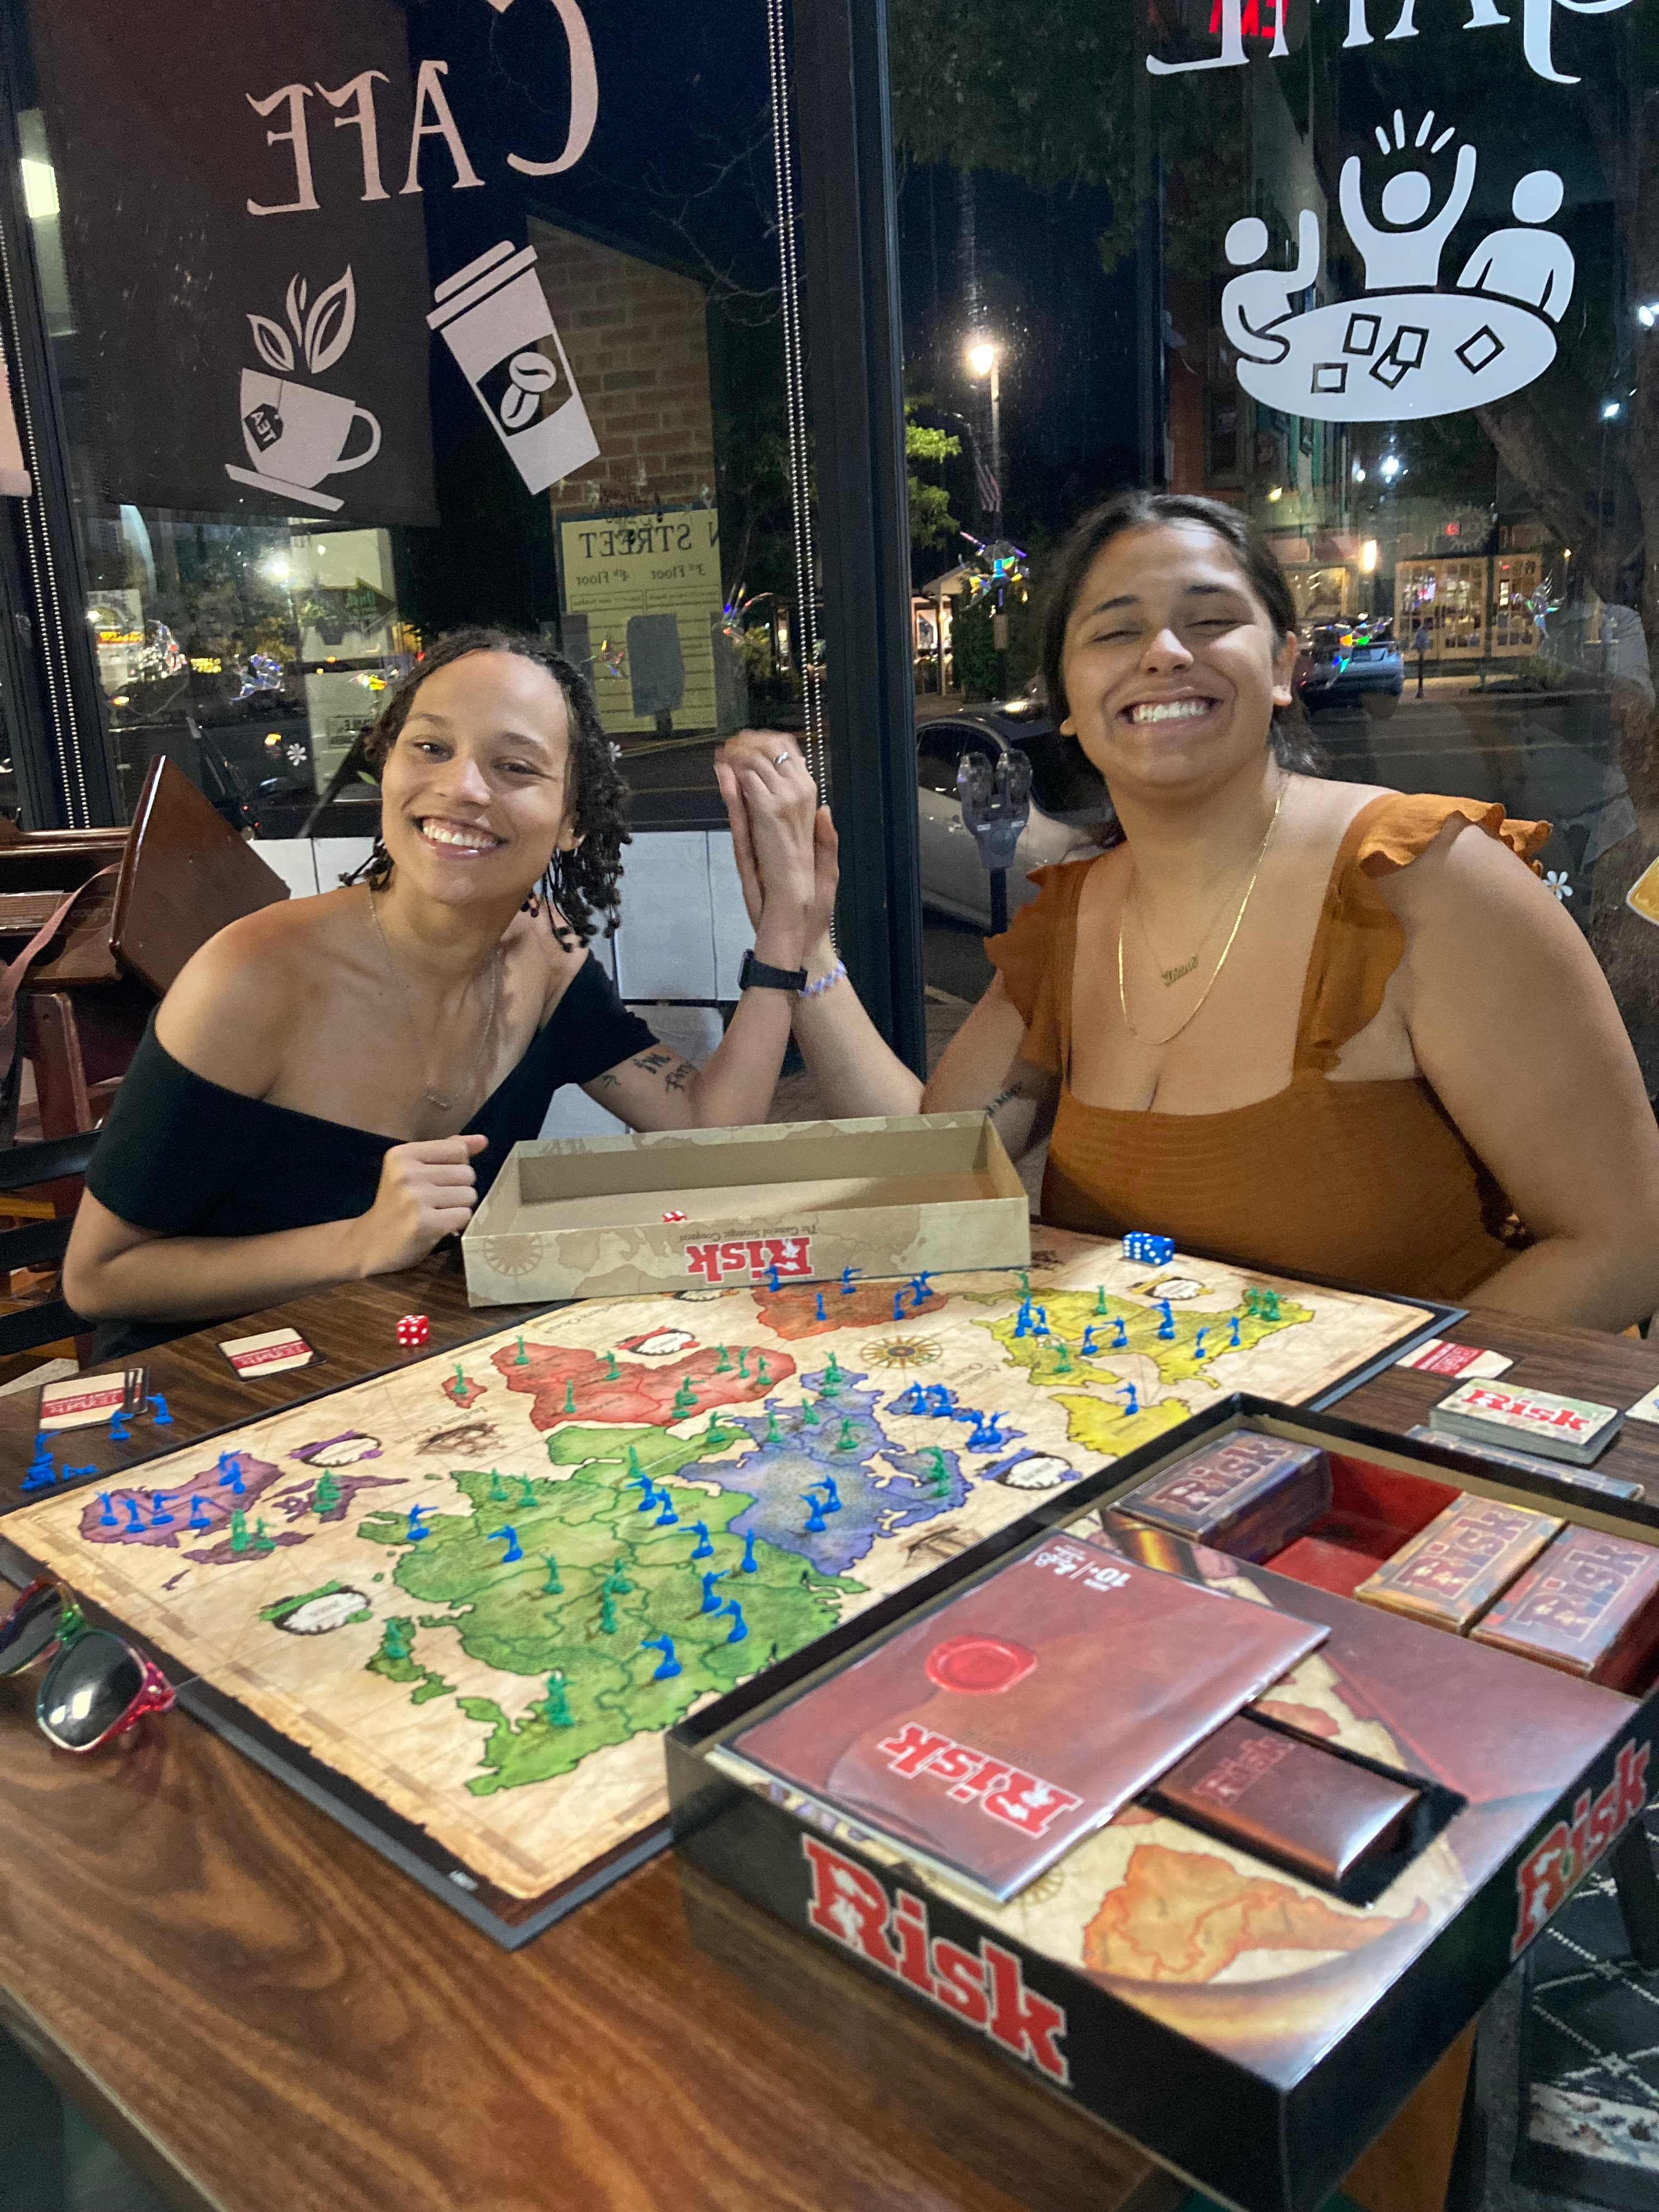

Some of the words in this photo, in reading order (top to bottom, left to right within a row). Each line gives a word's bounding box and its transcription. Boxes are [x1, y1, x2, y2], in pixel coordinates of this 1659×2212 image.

[685, 1236, 814, 1284] Risk
[394, 1425, 442, 1444] Ocean
[442, 1406, 489, 1426] Indian
[1461, 1387, 1590, 1431] Risk
[1151, 1437, 1295, 1516] Risk
[1392, 1508, 1533, 1600] Risk
[1510, 1538, 1651, 1640] Risk
[876, 1720, 1085, 1841] Risk
[1190, 1736, 1296, 1807] Risk
[1510, 1739, 1652, 1962] Risk
[800, 1832, 1073, 2088] Risk
